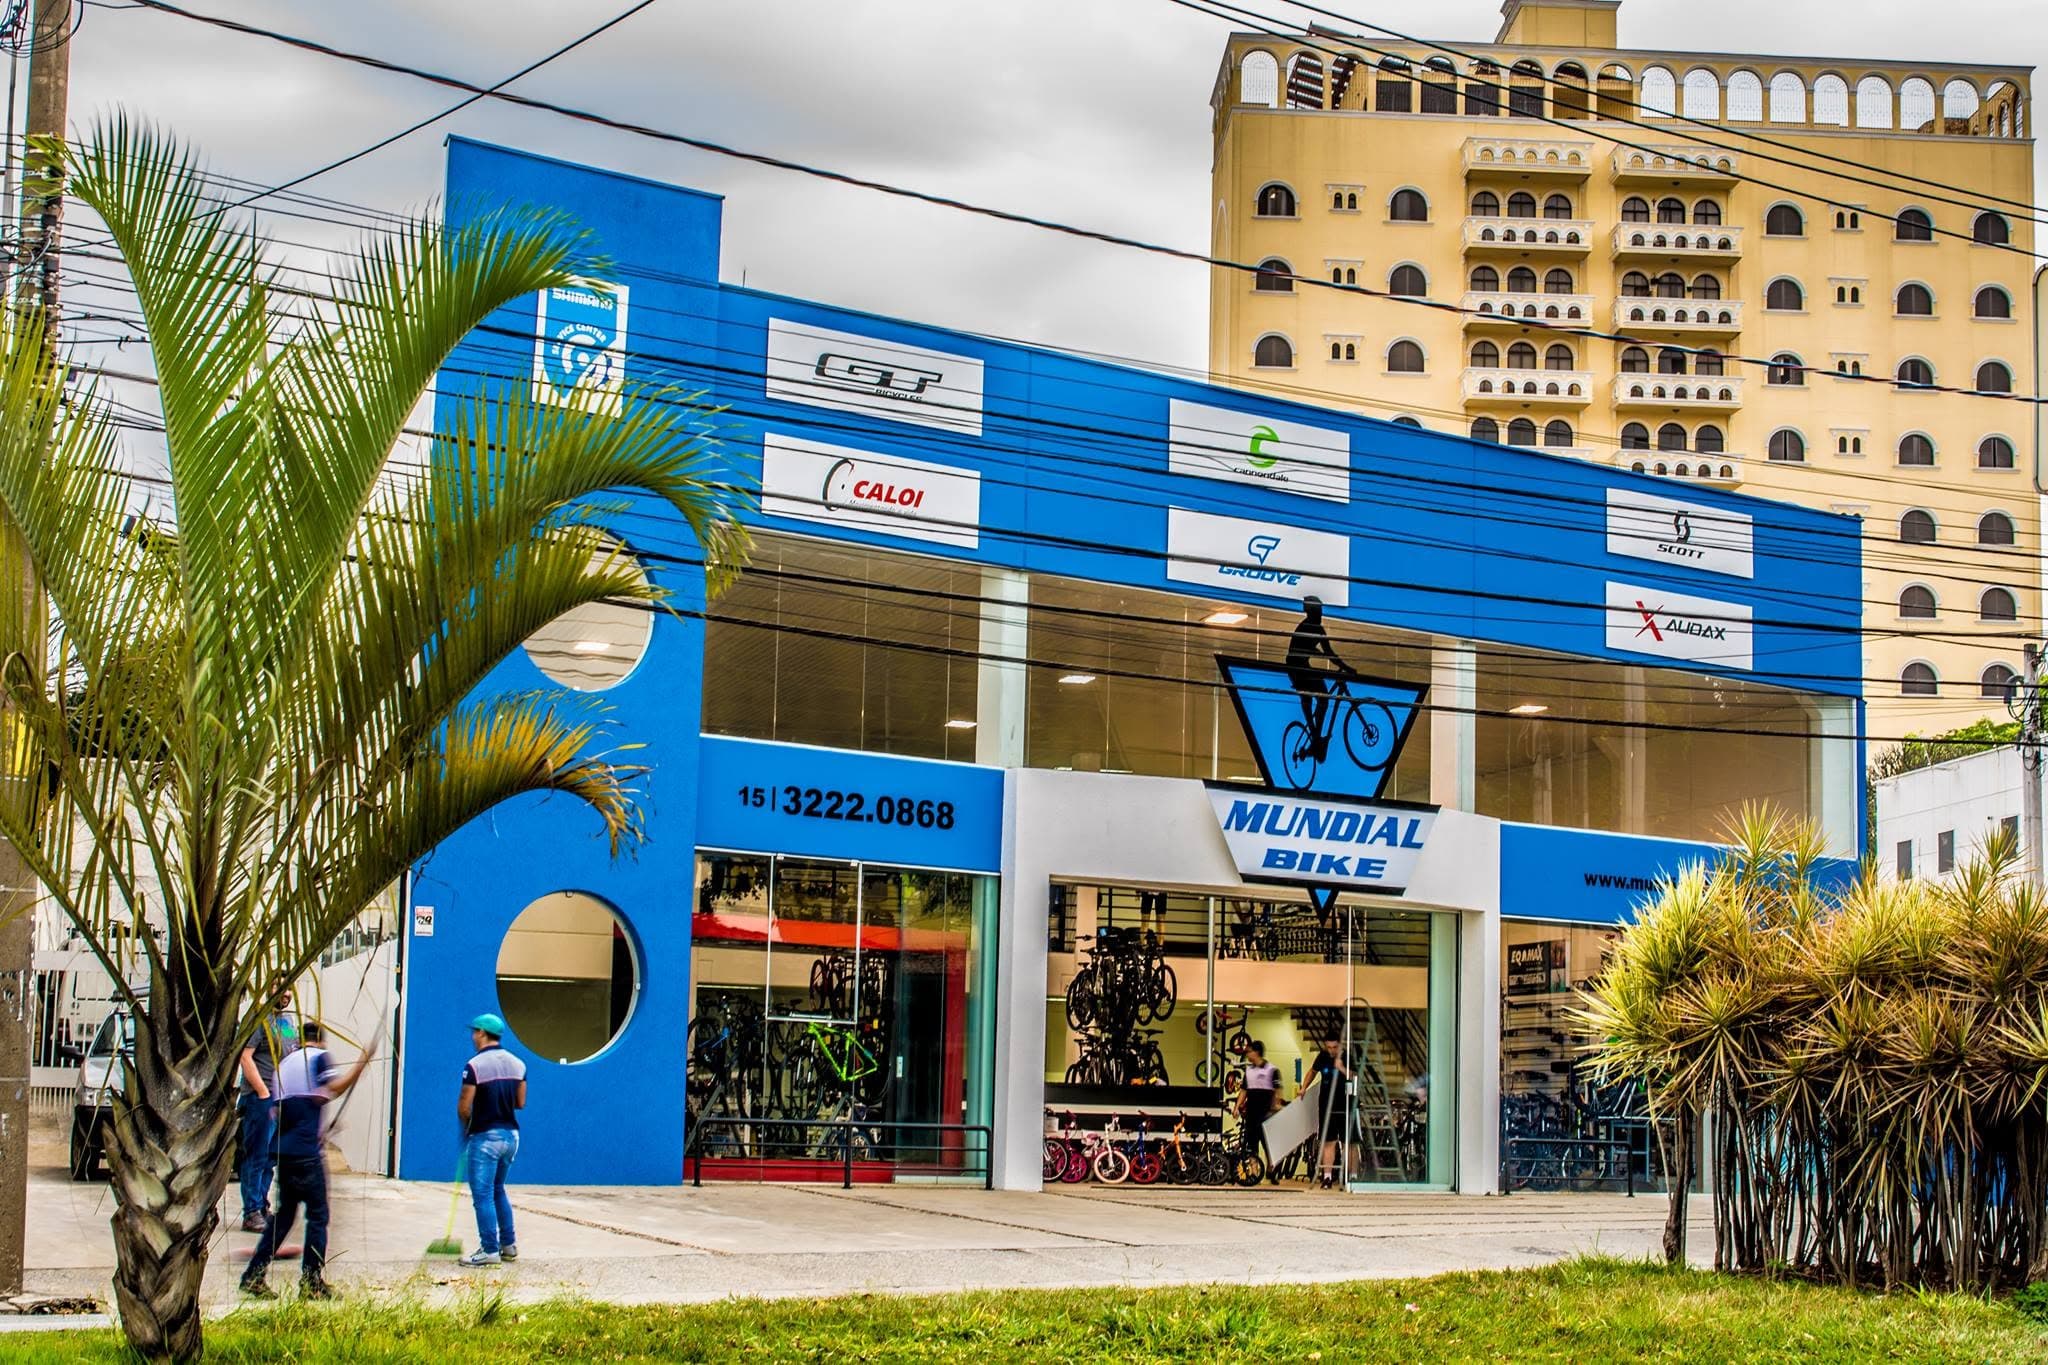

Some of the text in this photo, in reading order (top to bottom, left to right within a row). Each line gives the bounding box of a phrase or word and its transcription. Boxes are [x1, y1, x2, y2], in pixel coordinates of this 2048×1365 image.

[815, 353, 943, 394] GT
[853, 480, 925, 508] CALOI
[1656, 543, 1706, 559] SCOTT
[1218, 562, 1302, 586] GROOVE
[1665, 618, 1727, 641] AUDAX
[783, 785, 955, 830] 3222.0868
[1224, 800, 1424, 849] MUNDIAL
[1262, 848, 1387, 879] BIKE
